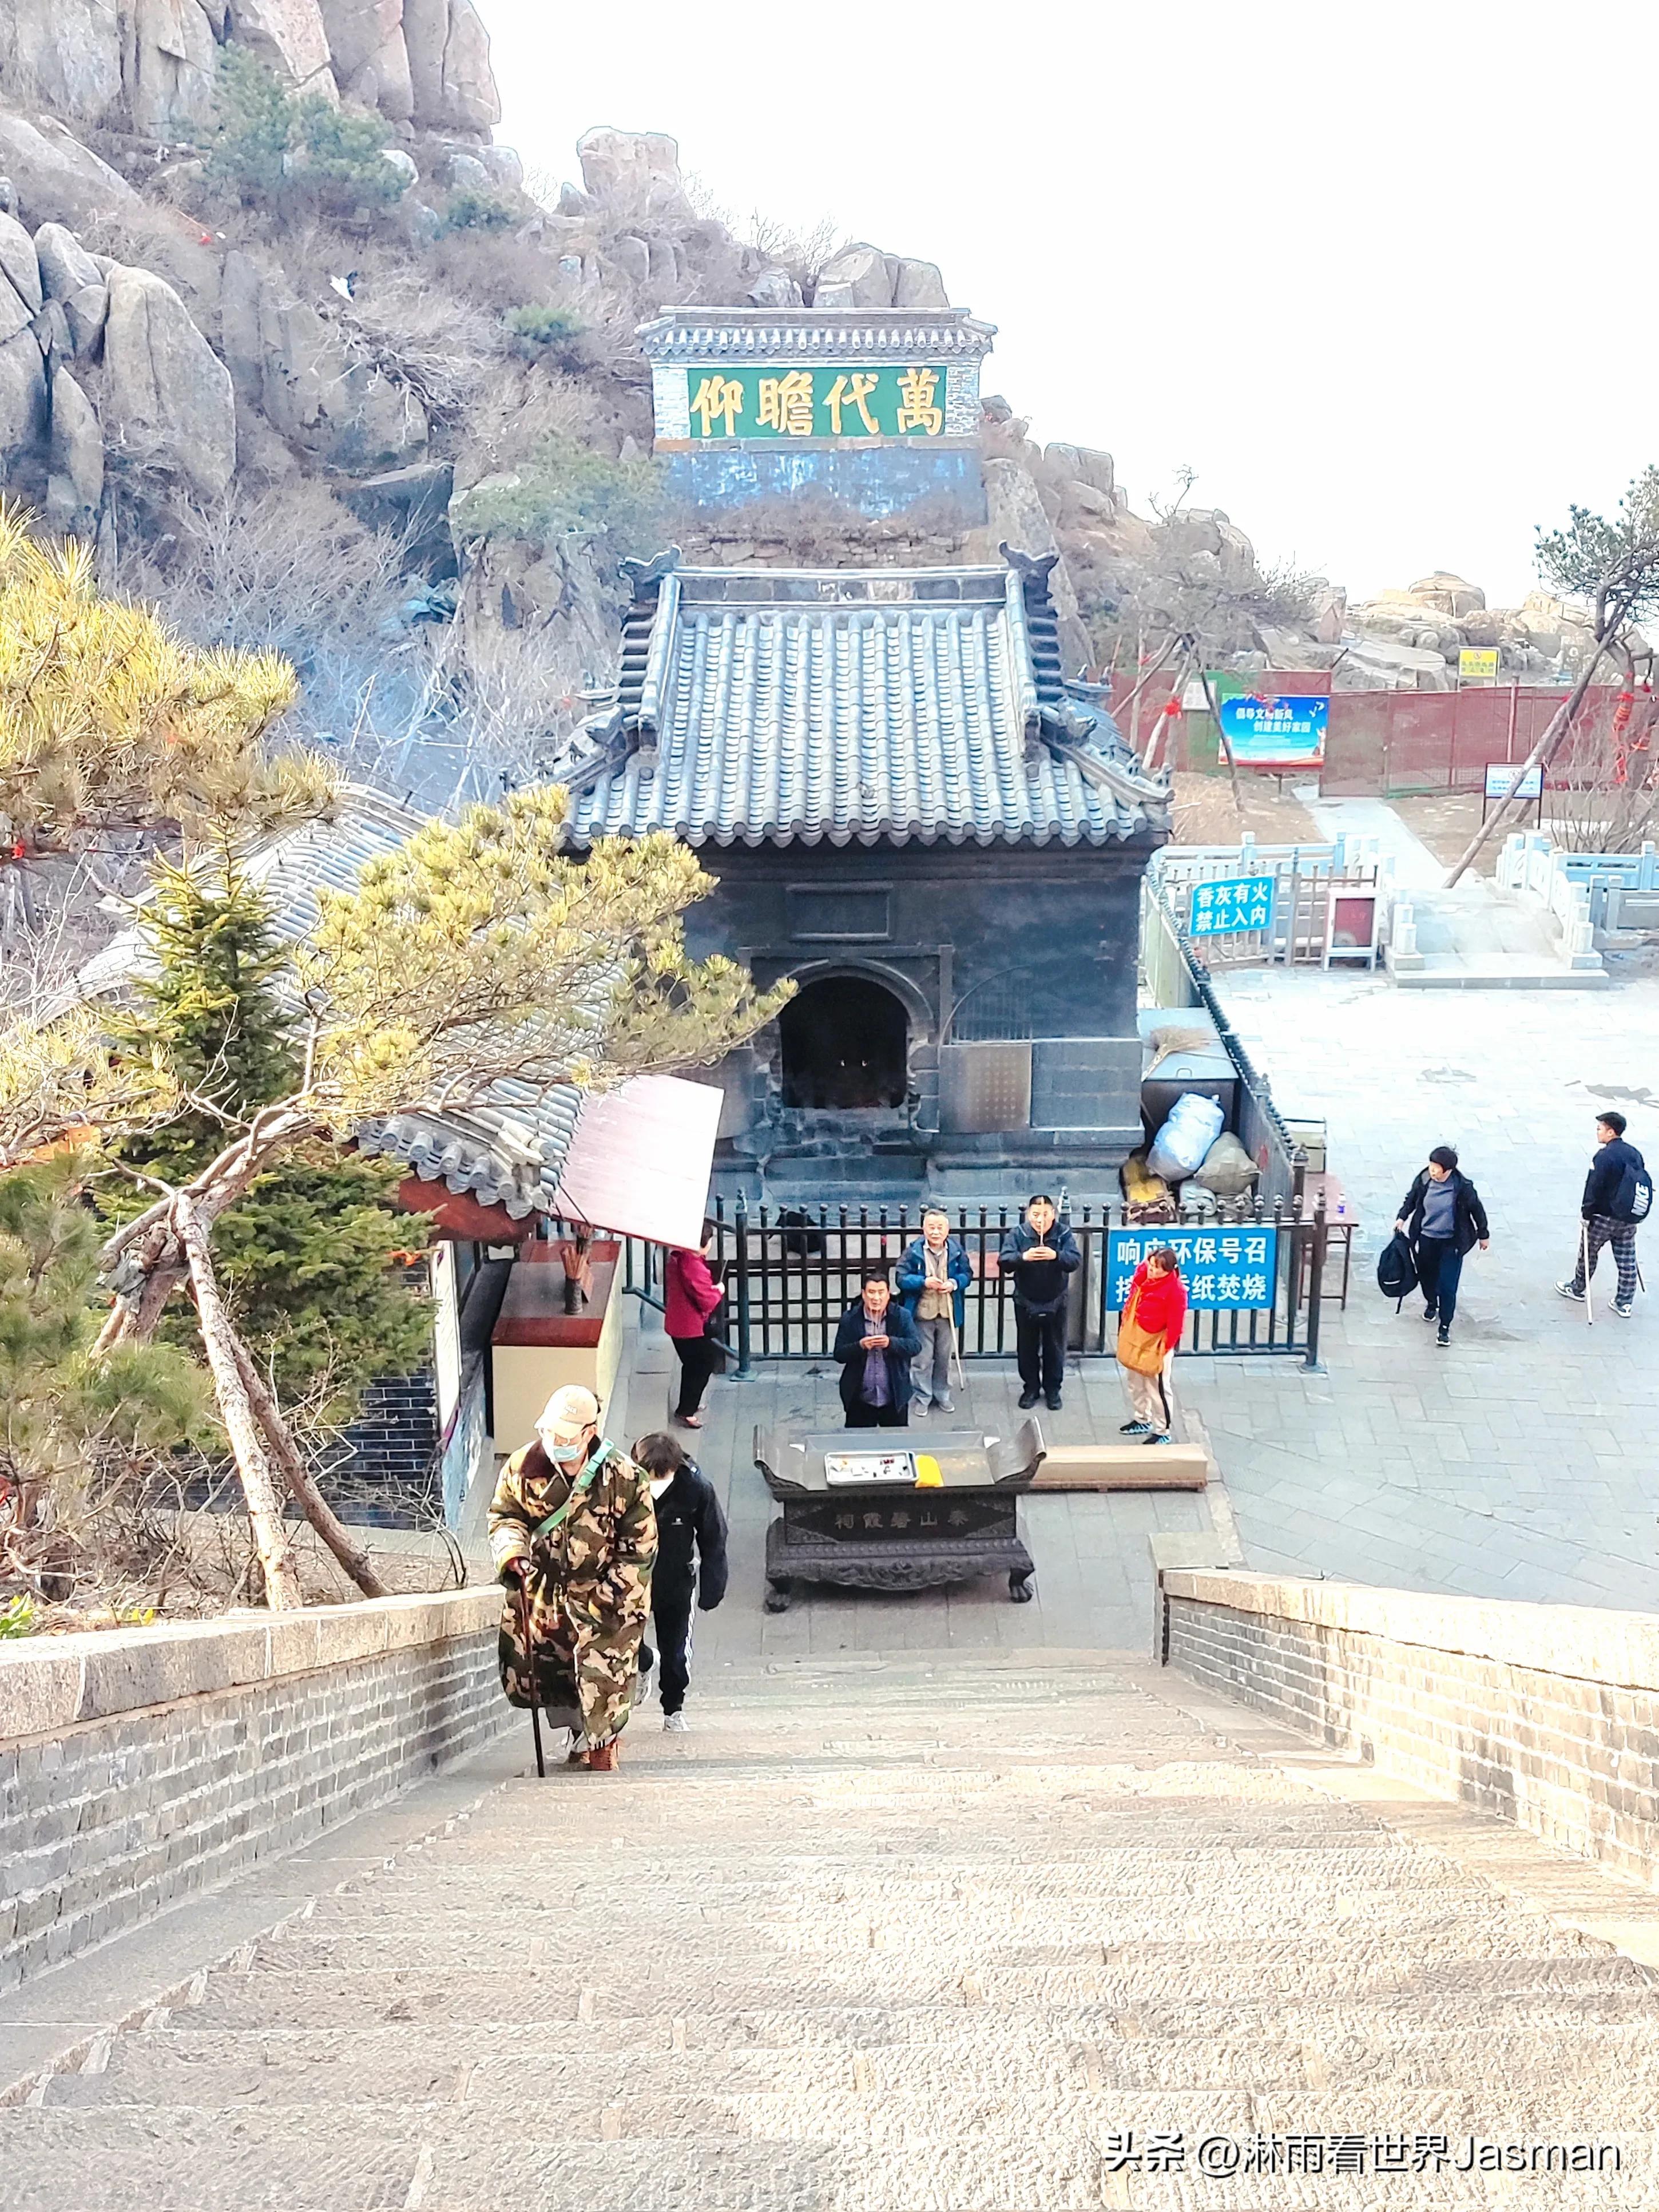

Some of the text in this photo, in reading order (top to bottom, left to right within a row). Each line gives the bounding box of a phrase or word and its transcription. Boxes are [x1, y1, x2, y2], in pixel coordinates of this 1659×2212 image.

[690, 368, 943, 437] 萬代瞻仰
[1253, 720, 1311, 733] 创建美好家园
[1197, 881, 1268, 909] 香灰有火
[1196, 905, 1266, 931] 禁止入内
[1631, 1182, 1649, 1215] NIKE
[1116, 1274, 1267, 1302] 控纸焚烧
